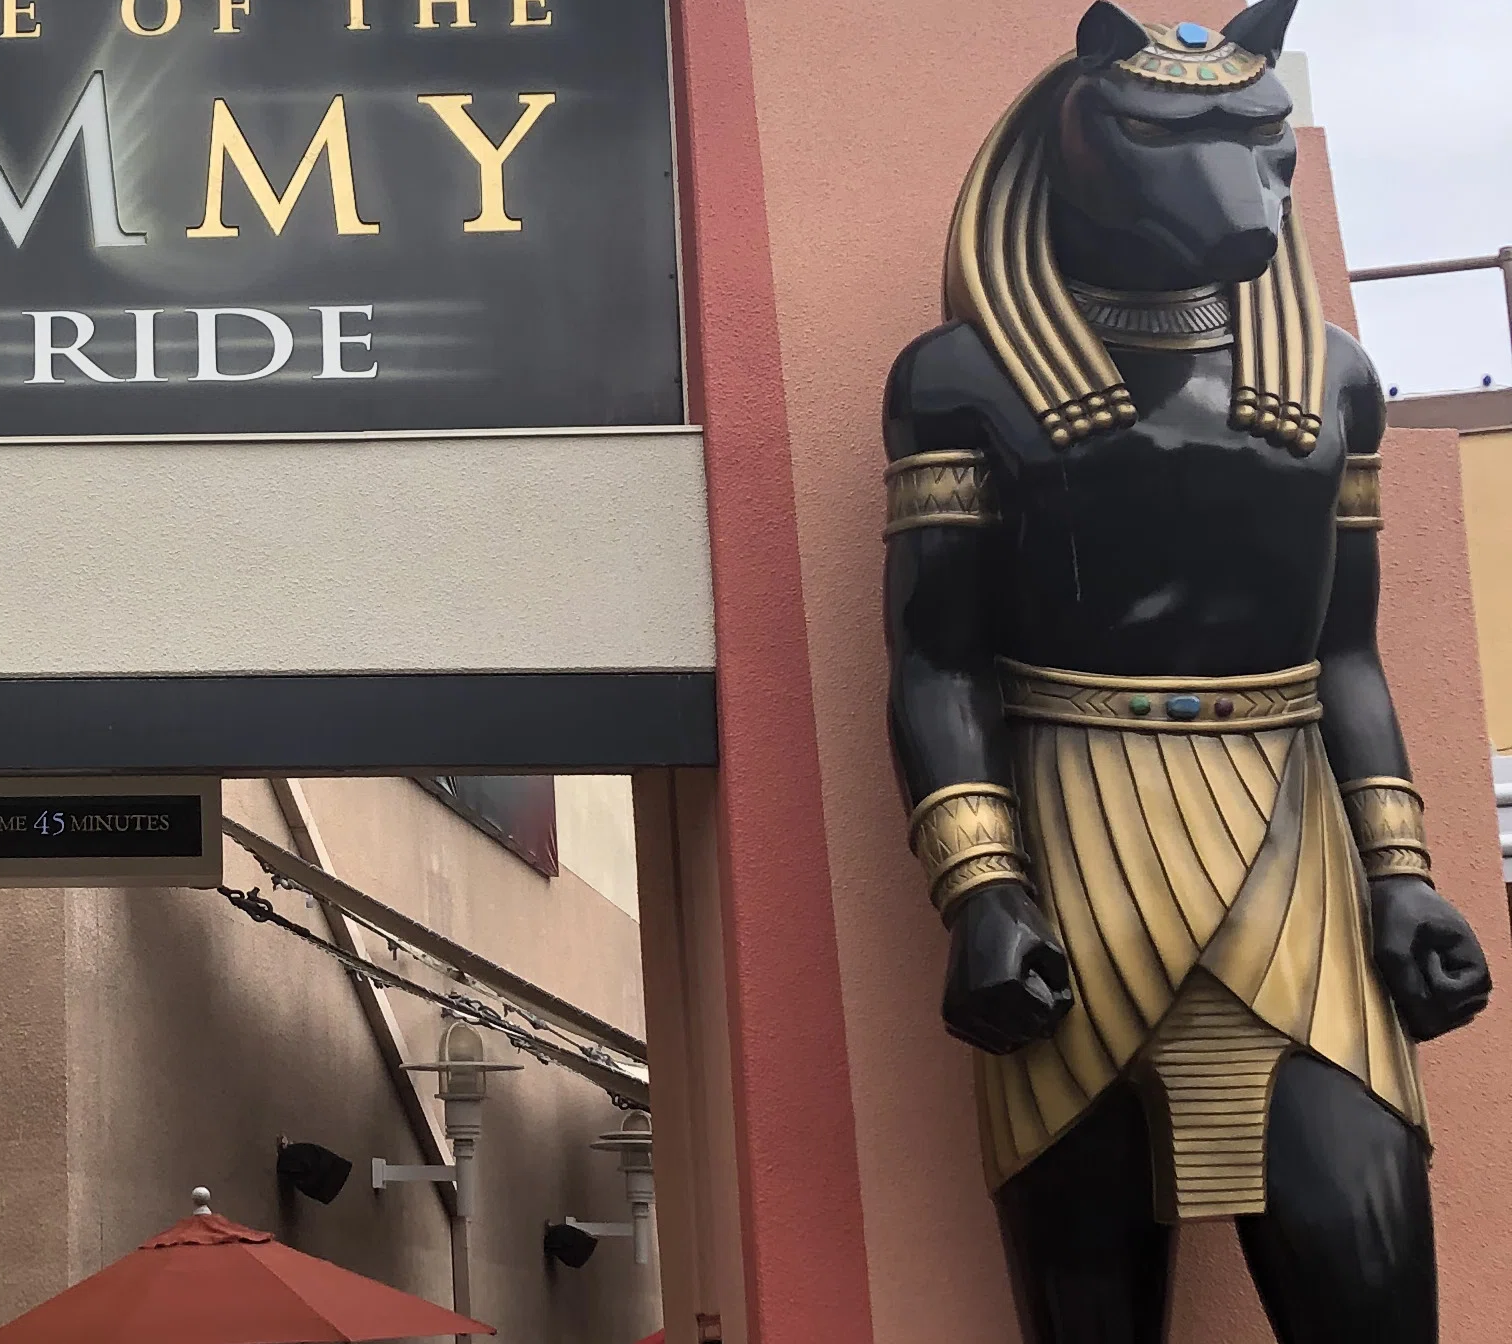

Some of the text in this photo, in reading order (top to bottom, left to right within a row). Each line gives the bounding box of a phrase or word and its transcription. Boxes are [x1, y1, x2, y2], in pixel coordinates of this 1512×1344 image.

[21, 304, 379, 384] RIDE
[33, 810, 65, 836] 45
[71, 814, 170, 833] MINUTES
